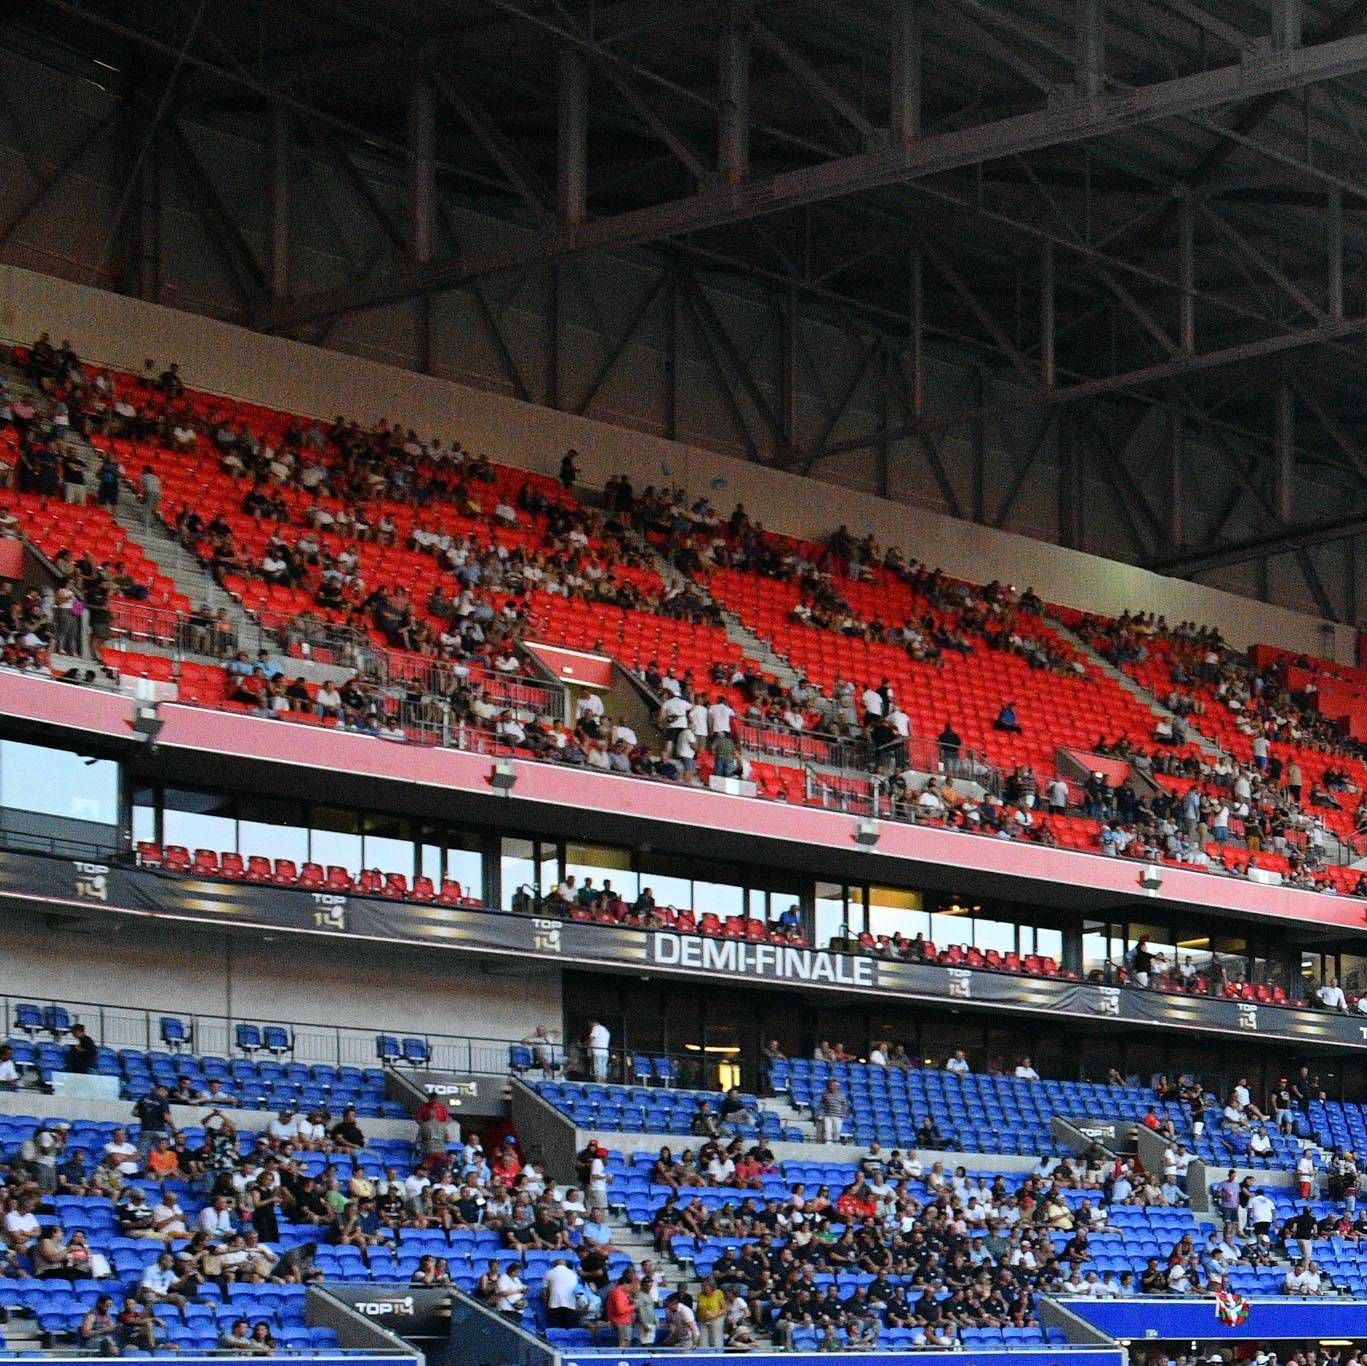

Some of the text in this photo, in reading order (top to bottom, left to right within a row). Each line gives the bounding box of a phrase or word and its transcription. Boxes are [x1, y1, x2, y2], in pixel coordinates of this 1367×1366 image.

[72, 861, 110, 875] TOP
[76, 878, 108, 901] 14
[312, 893, 347, 905] TOP
[314, 907, 345, 929] 14
[532, 918, 563, 930] TOP
[534, 932, 561, 952] 14
[654, 932, 873, 986] DEMI-FINALE
[948, 967, 972, 979] TOP
[1098, 985, 1121, 996] TOP
[1237, 1003, 1258, 1013] TOP
